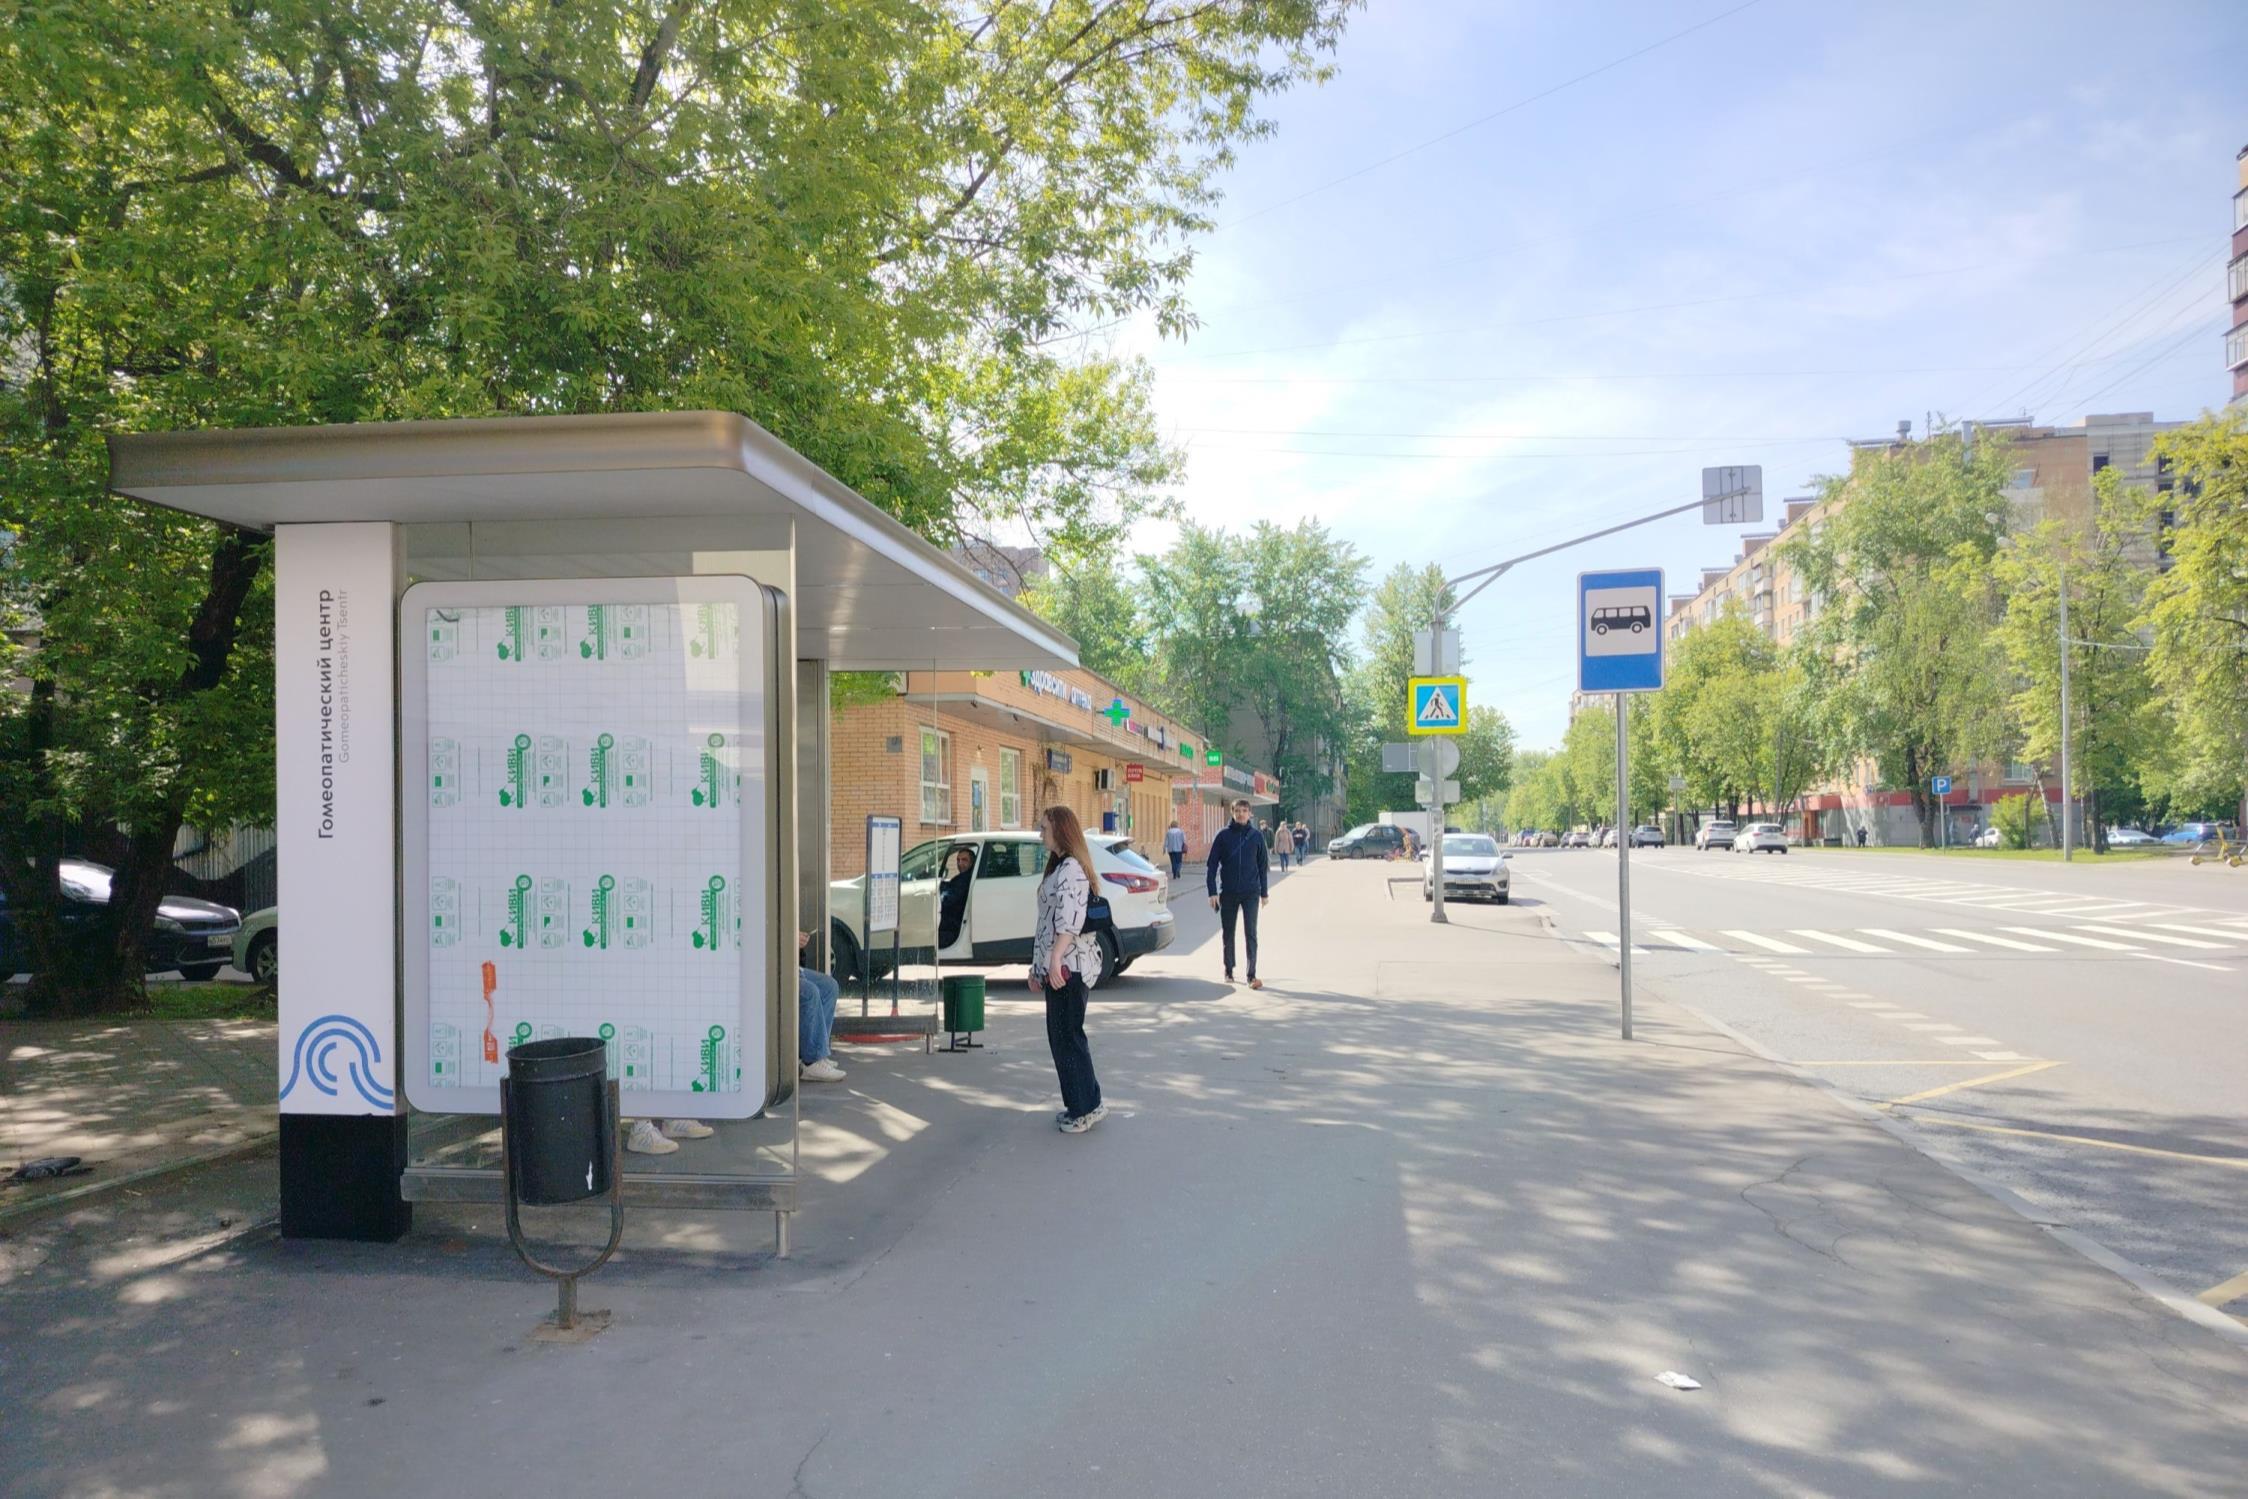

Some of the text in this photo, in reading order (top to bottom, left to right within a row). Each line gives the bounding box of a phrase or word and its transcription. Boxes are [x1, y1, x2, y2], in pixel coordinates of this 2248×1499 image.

[337, 589, 350, 631] Tsentr
[316, 589, 335, 839] Гомеопатический центр
[507, 748, 517, 784] КИВИ
[590, 747, 600, 783] КИВИ
[1937, 779, 1947, 792] P
[508, 888, 518, 924] КИВИ
[591, 888, 601, 925] КИВИ
[700, 889, 710, 926] КИВИ
[700, 1039, 710, 1075] КИВИ
